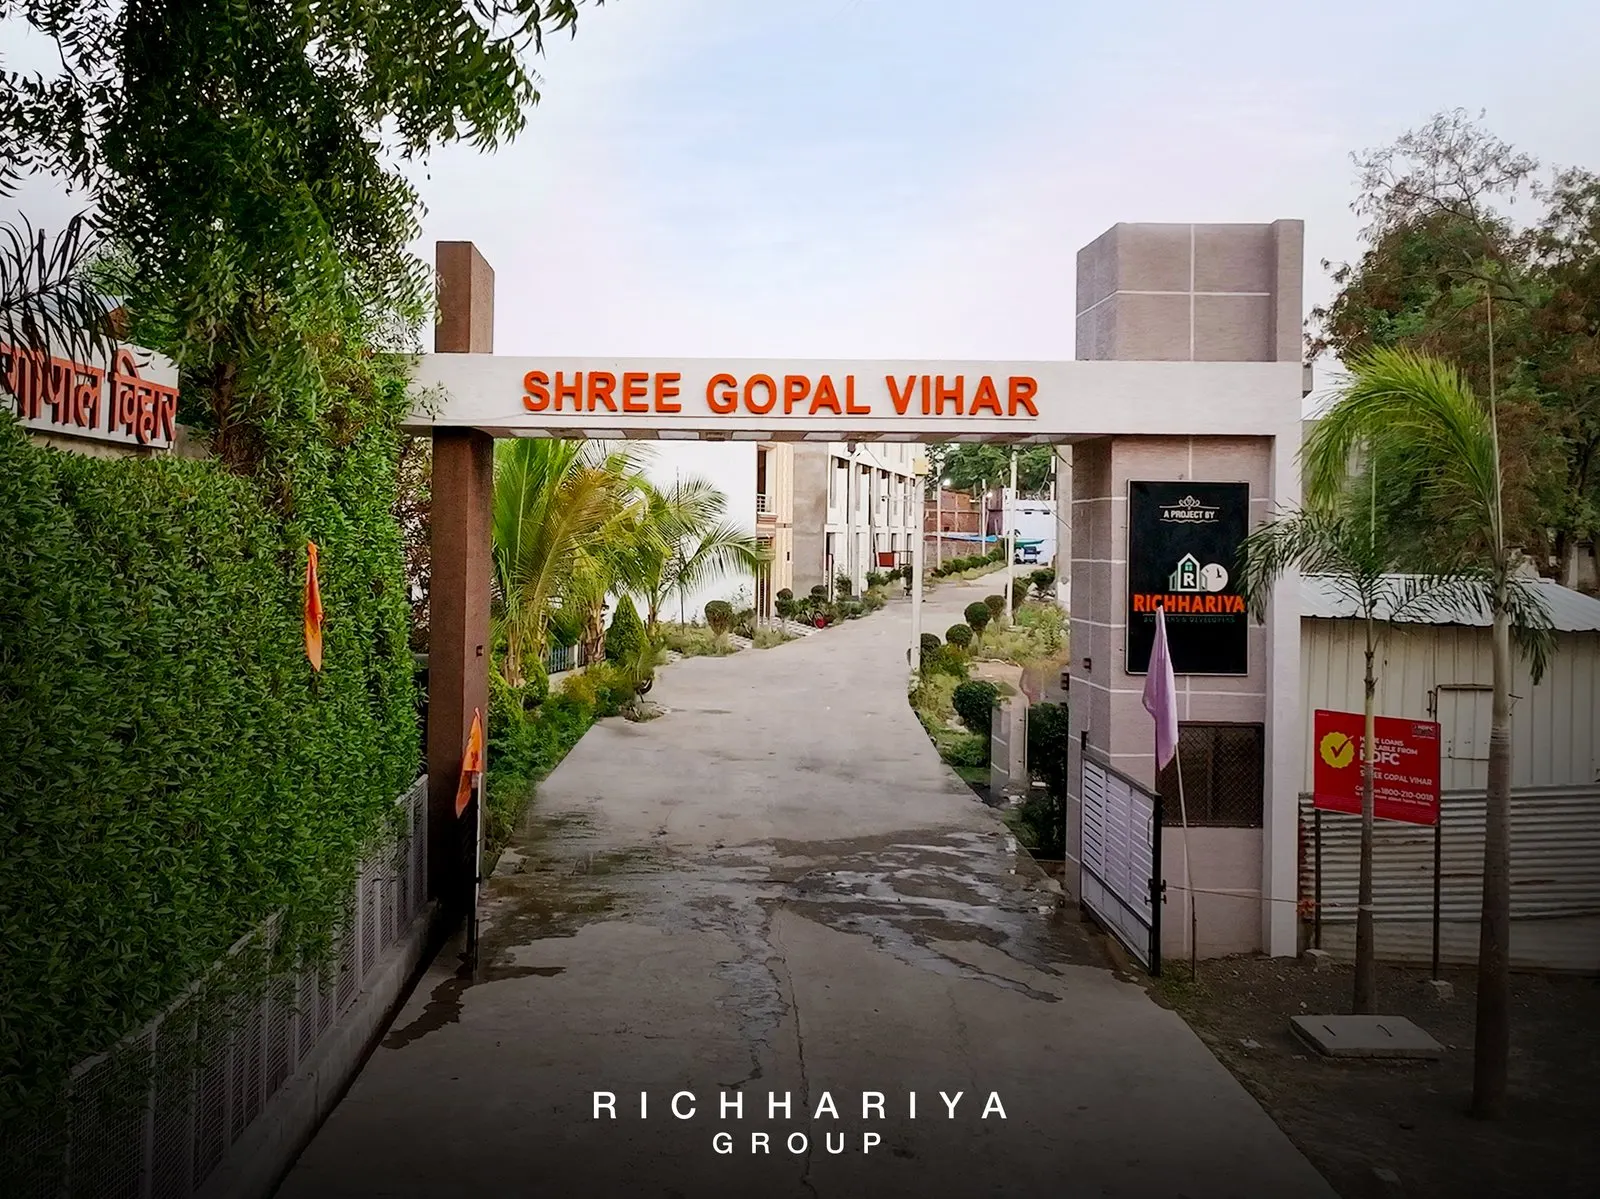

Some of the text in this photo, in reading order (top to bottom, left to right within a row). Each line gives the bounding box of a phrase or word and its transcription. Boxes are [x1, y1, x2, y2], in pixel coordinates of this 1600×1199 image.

[109, 348, 180, 445] विहार
[521, 369, 1040, 418] SHREE GOPAL VIHAR
[1163, 510, 1215, 519] A PROJECT BY
[1183, 572, 1195, 587] R
[1133, 594, 1245, 613] RICHHARIYA
[1381, 738, 1404, 746] LOANS
[1397, 747, 1418, 755] FROM
[1384, 773, 1408, 783] GOPAL
[1409, 776, 1432, 785] VIHAR
